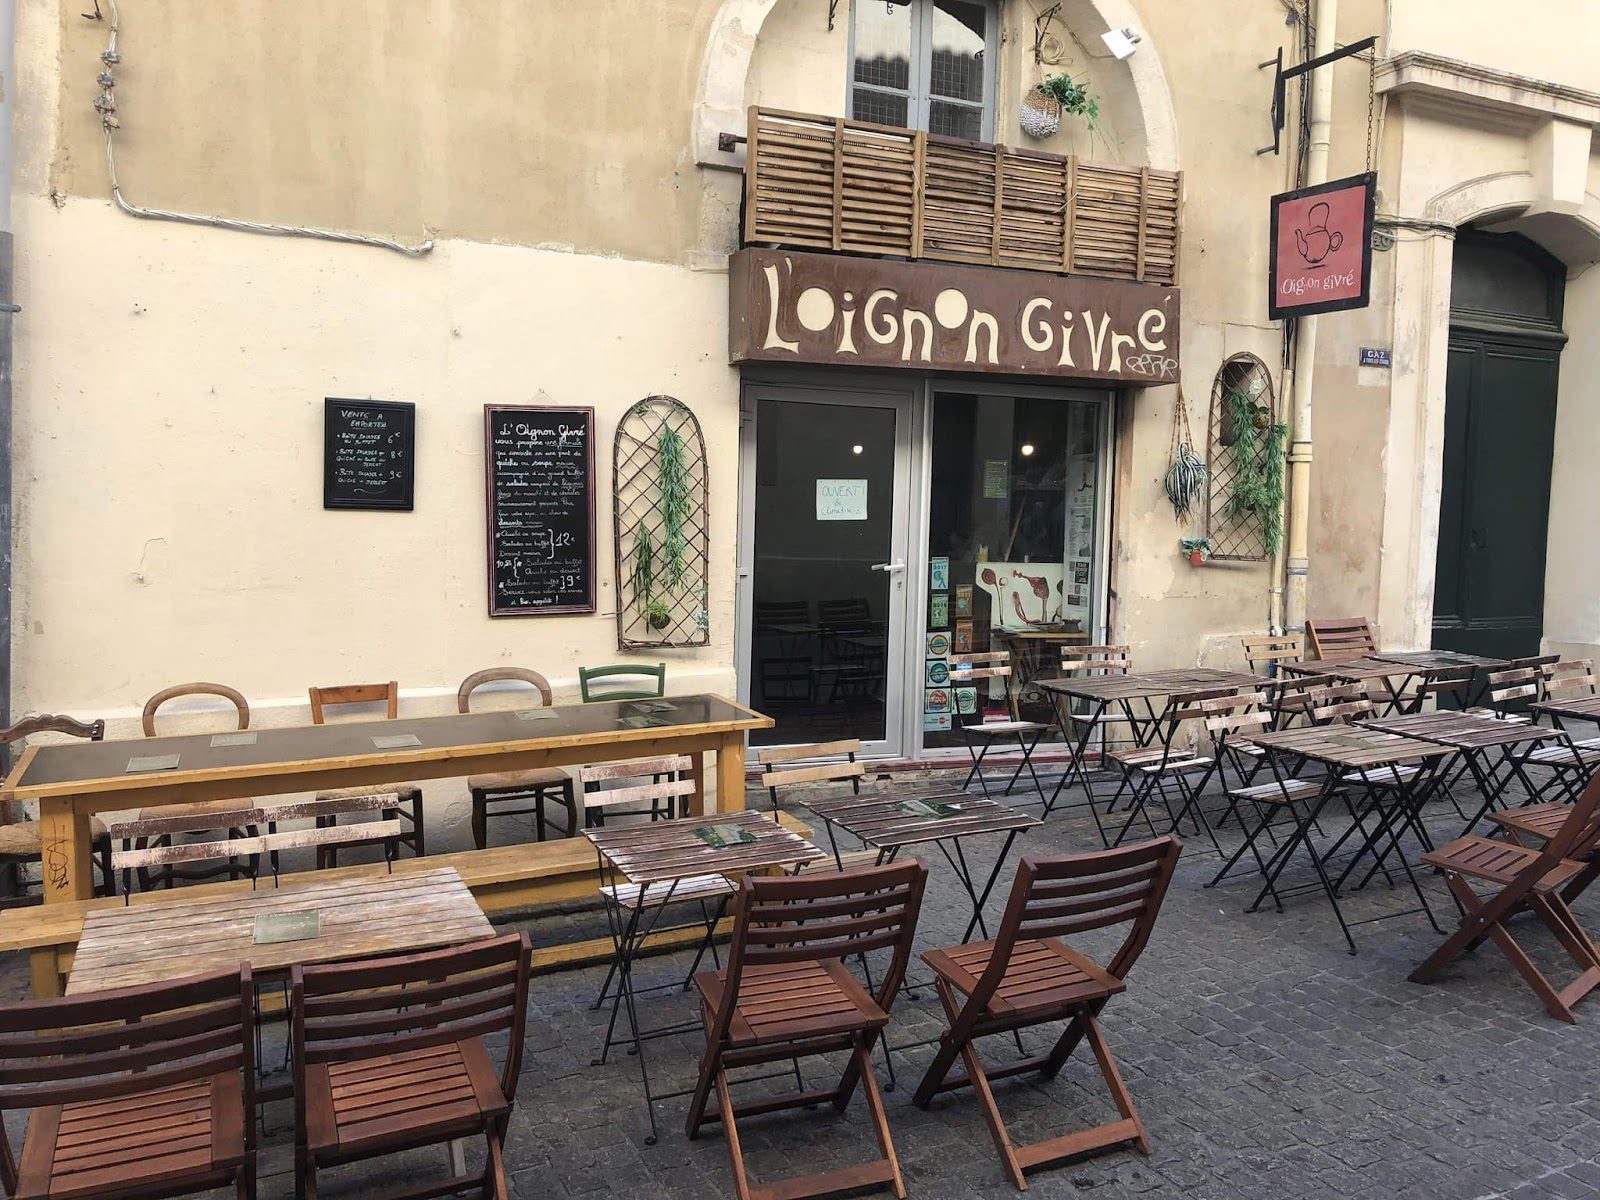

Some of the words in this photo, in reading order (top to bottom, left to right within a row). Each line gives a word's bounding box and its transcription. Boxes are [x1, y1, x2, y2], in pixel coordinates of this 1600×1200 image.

[1367, 350, 1385, 359] GAZ
[341, 410, 370, 419] VENTE
[350, 420, 388, 428] EMPORTER
[515, 423, 556, 441] Oignon
[558, 424, 585, 442] Givré
[496, 458, 518, 470] quiche
[505, 479, 529, 487] salades
